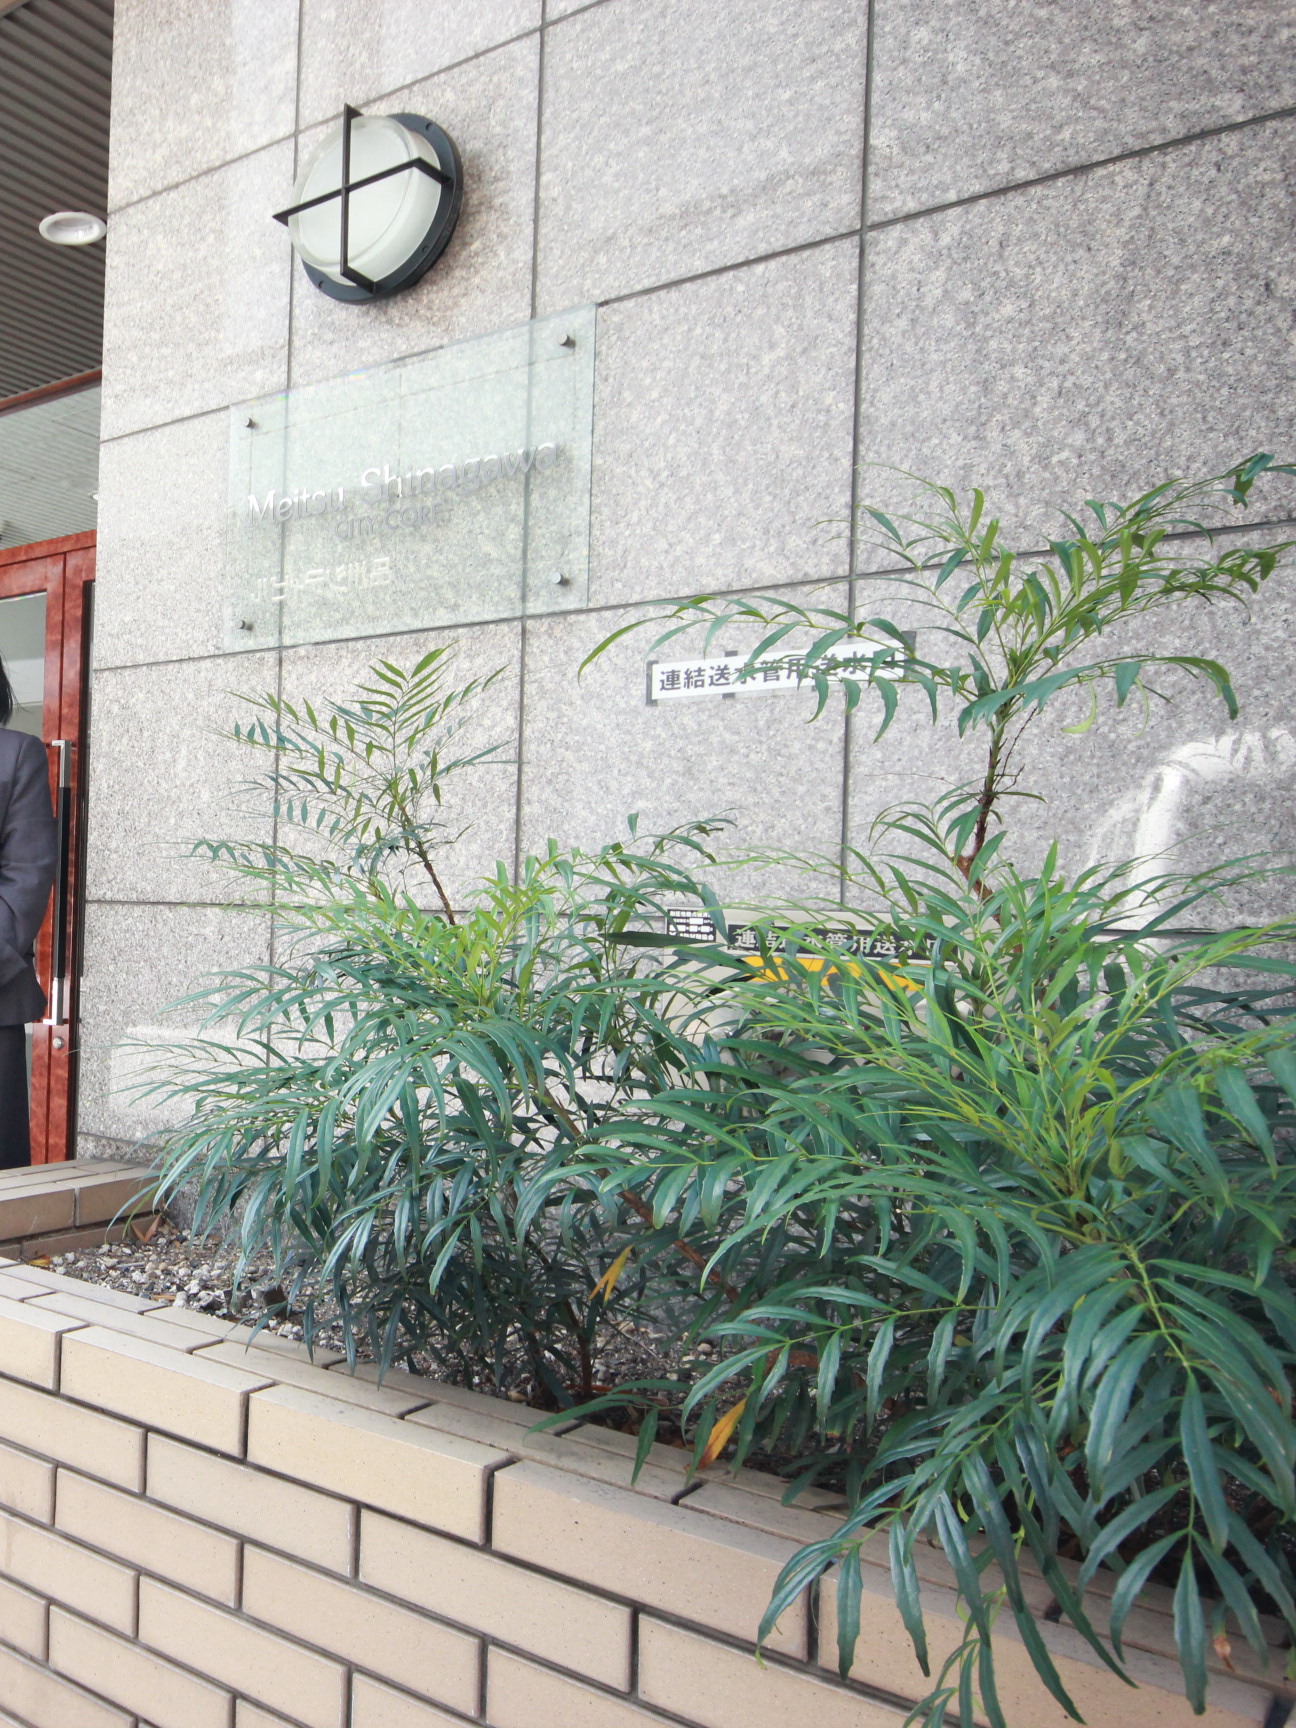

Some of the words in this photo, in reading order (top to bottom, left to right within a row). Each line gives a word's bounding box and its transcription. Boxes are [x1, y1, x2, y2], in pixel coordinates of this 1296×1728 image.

[248, 485, 345, 528] Meitsu
[361, 442, 561, 503] Shinagawa
[335, 514, 378, 540] CITY
[385, 506, 443, 532] CORE
